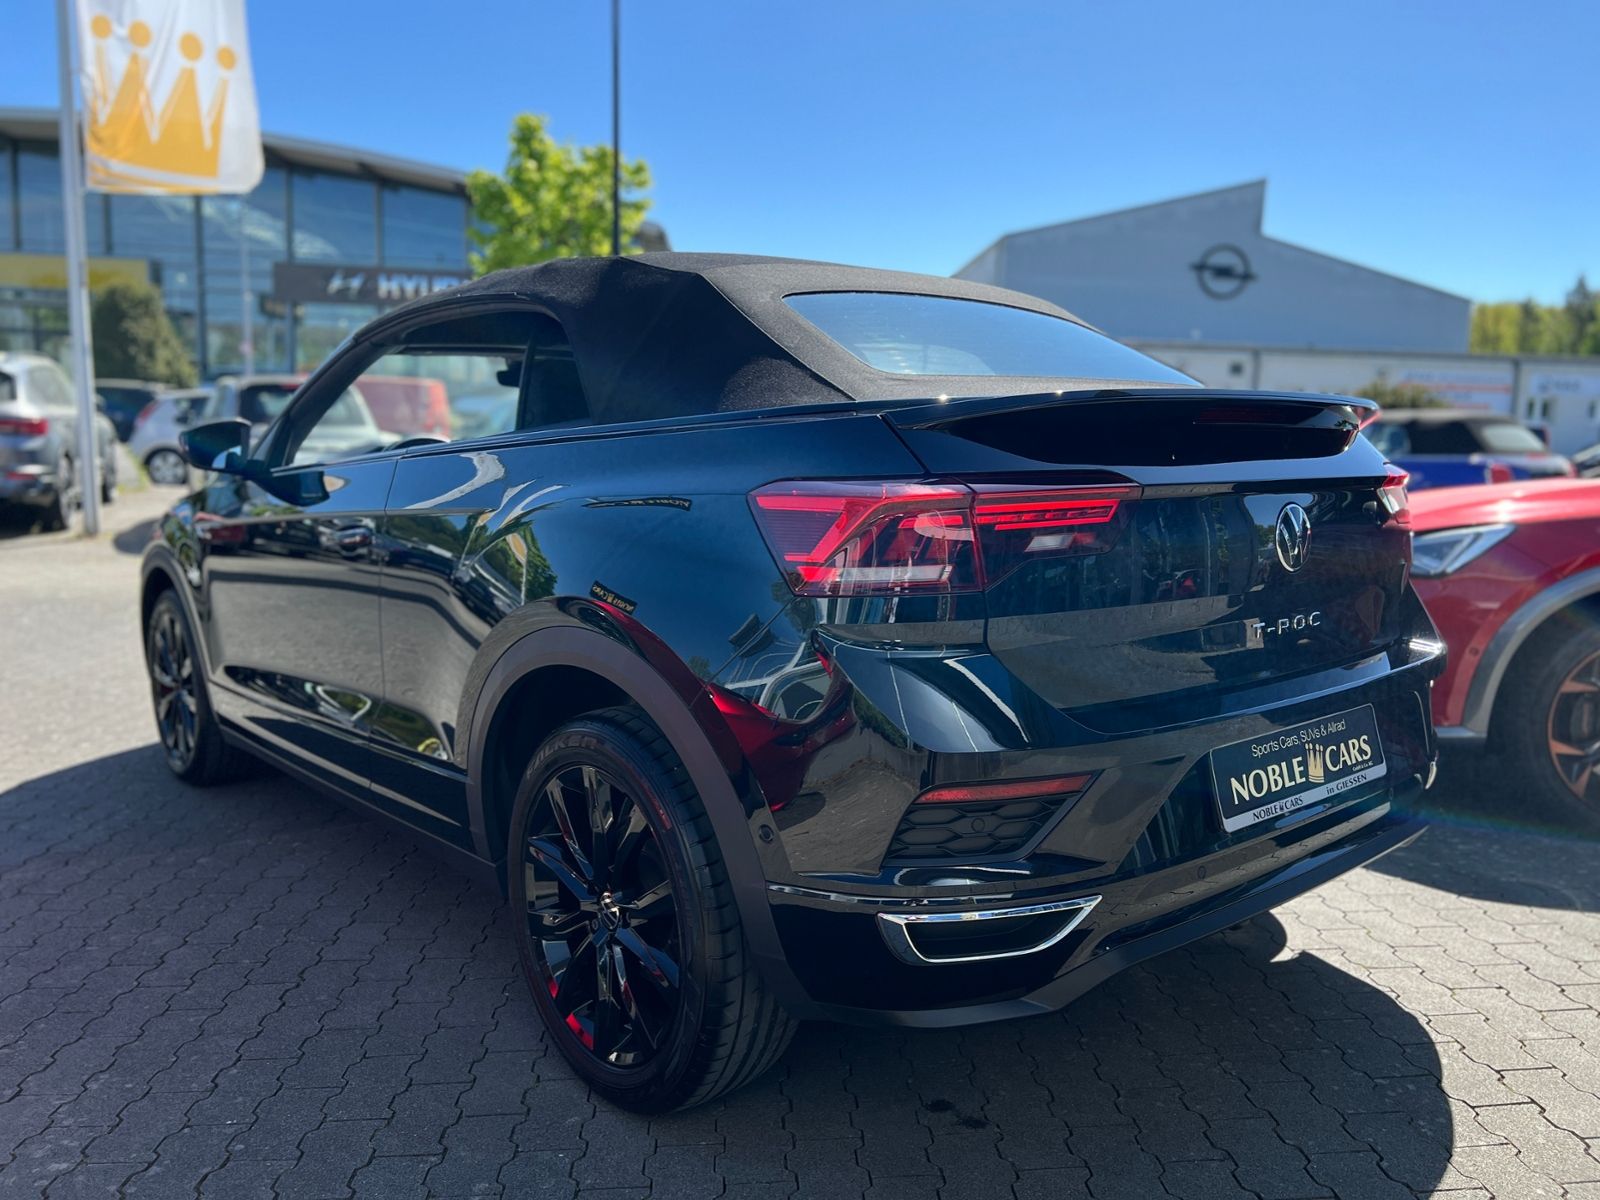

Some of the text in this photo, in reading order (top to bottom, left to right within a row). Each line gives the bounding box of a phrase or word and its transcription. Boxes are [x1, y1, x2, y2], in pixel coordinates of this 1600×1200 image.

[1252, 611, 1321, 639] T-ROC
[1251, 718, 1346, 758] Sports Cars, SUVs & Allrad
[1230, 735, 1372, 805] NOBLE CARS
[1252, 773, 1368, 821] NOBLE CARS in GIESSEN
